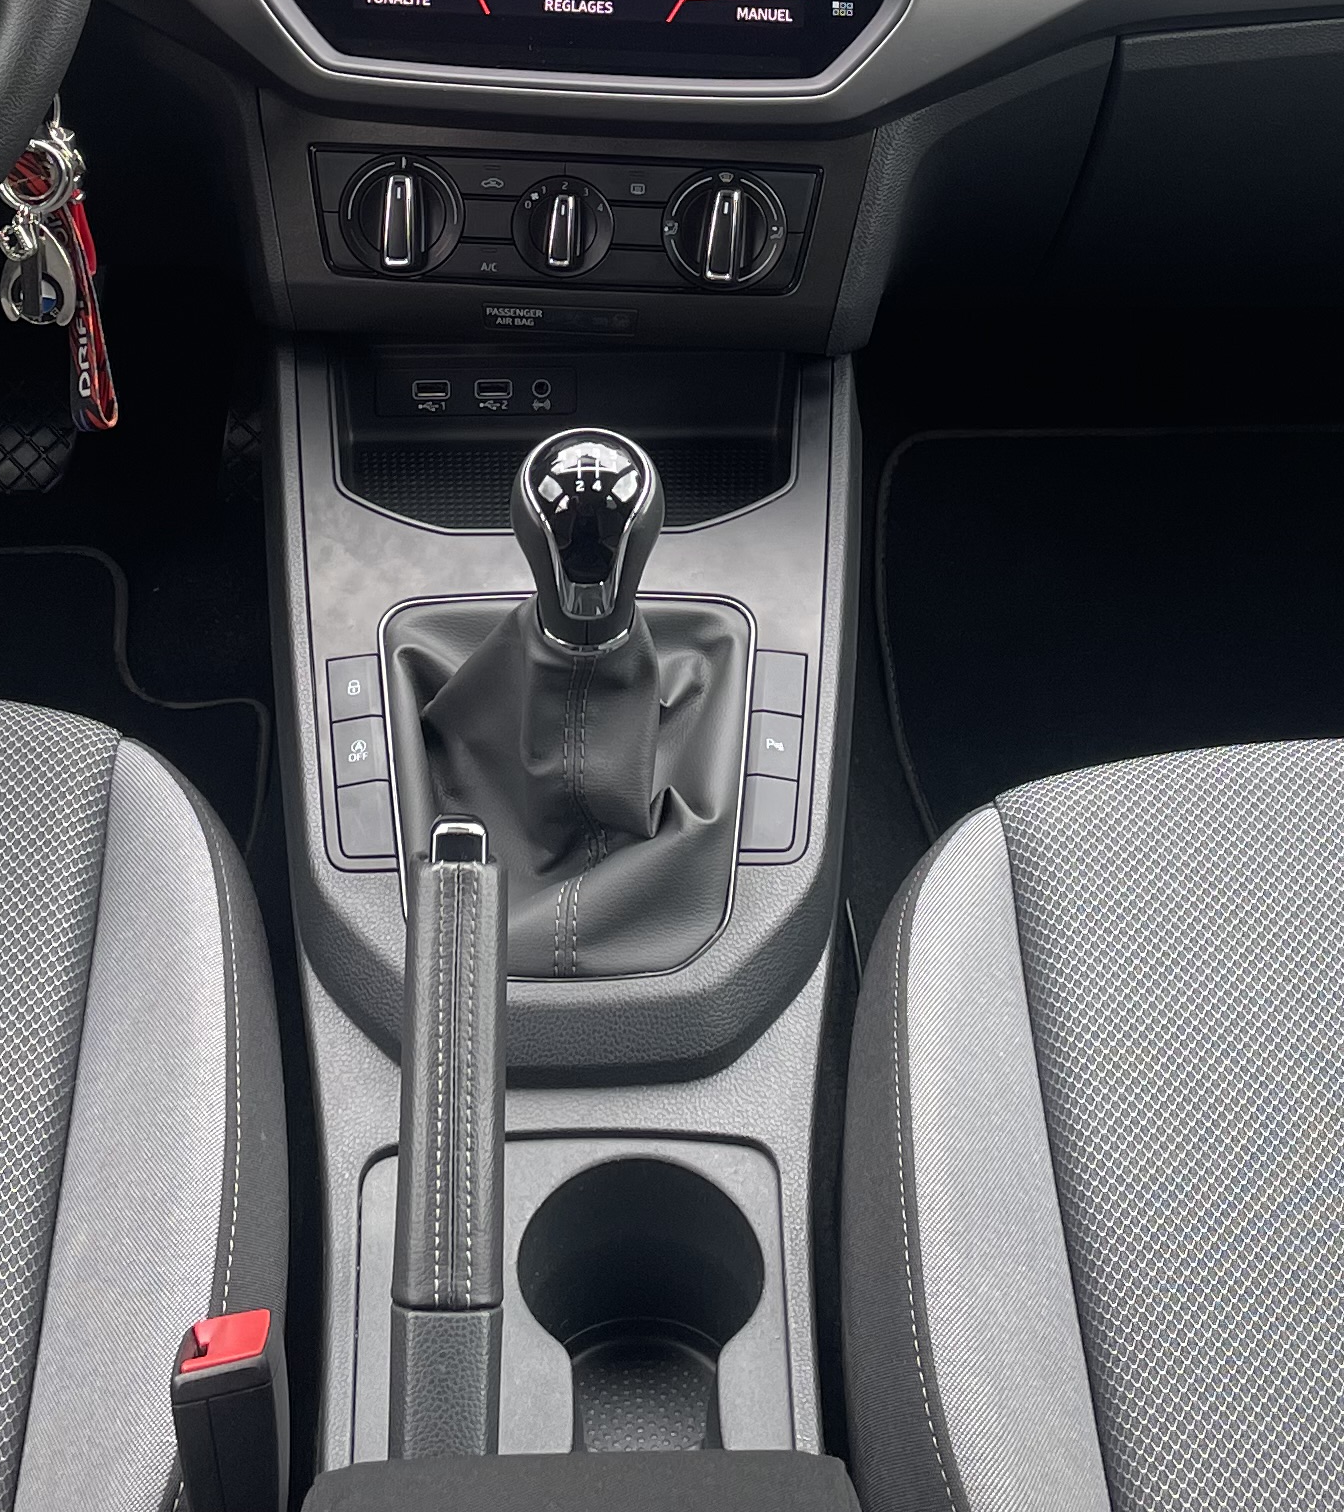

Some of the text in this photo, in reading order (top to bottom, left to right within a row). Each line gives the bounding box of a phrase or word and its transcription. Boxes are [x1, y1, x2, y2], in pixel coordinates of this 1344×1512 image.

[736, 6, 793, 23] MANUEL
[561, 181, 569, 190] 2
[597, 204, 604, 212] 4
[481, 262, 498, 272] A/C
[486, 307, 543, 318] PASSENGER
[495, 317, 535, 327] AIR BAG
[501, 400, 508, 410] 2
[575, 480, 586, 492] 2
[592, 479, 602, 492] 4
[348, 751, 368, 763] OFF
